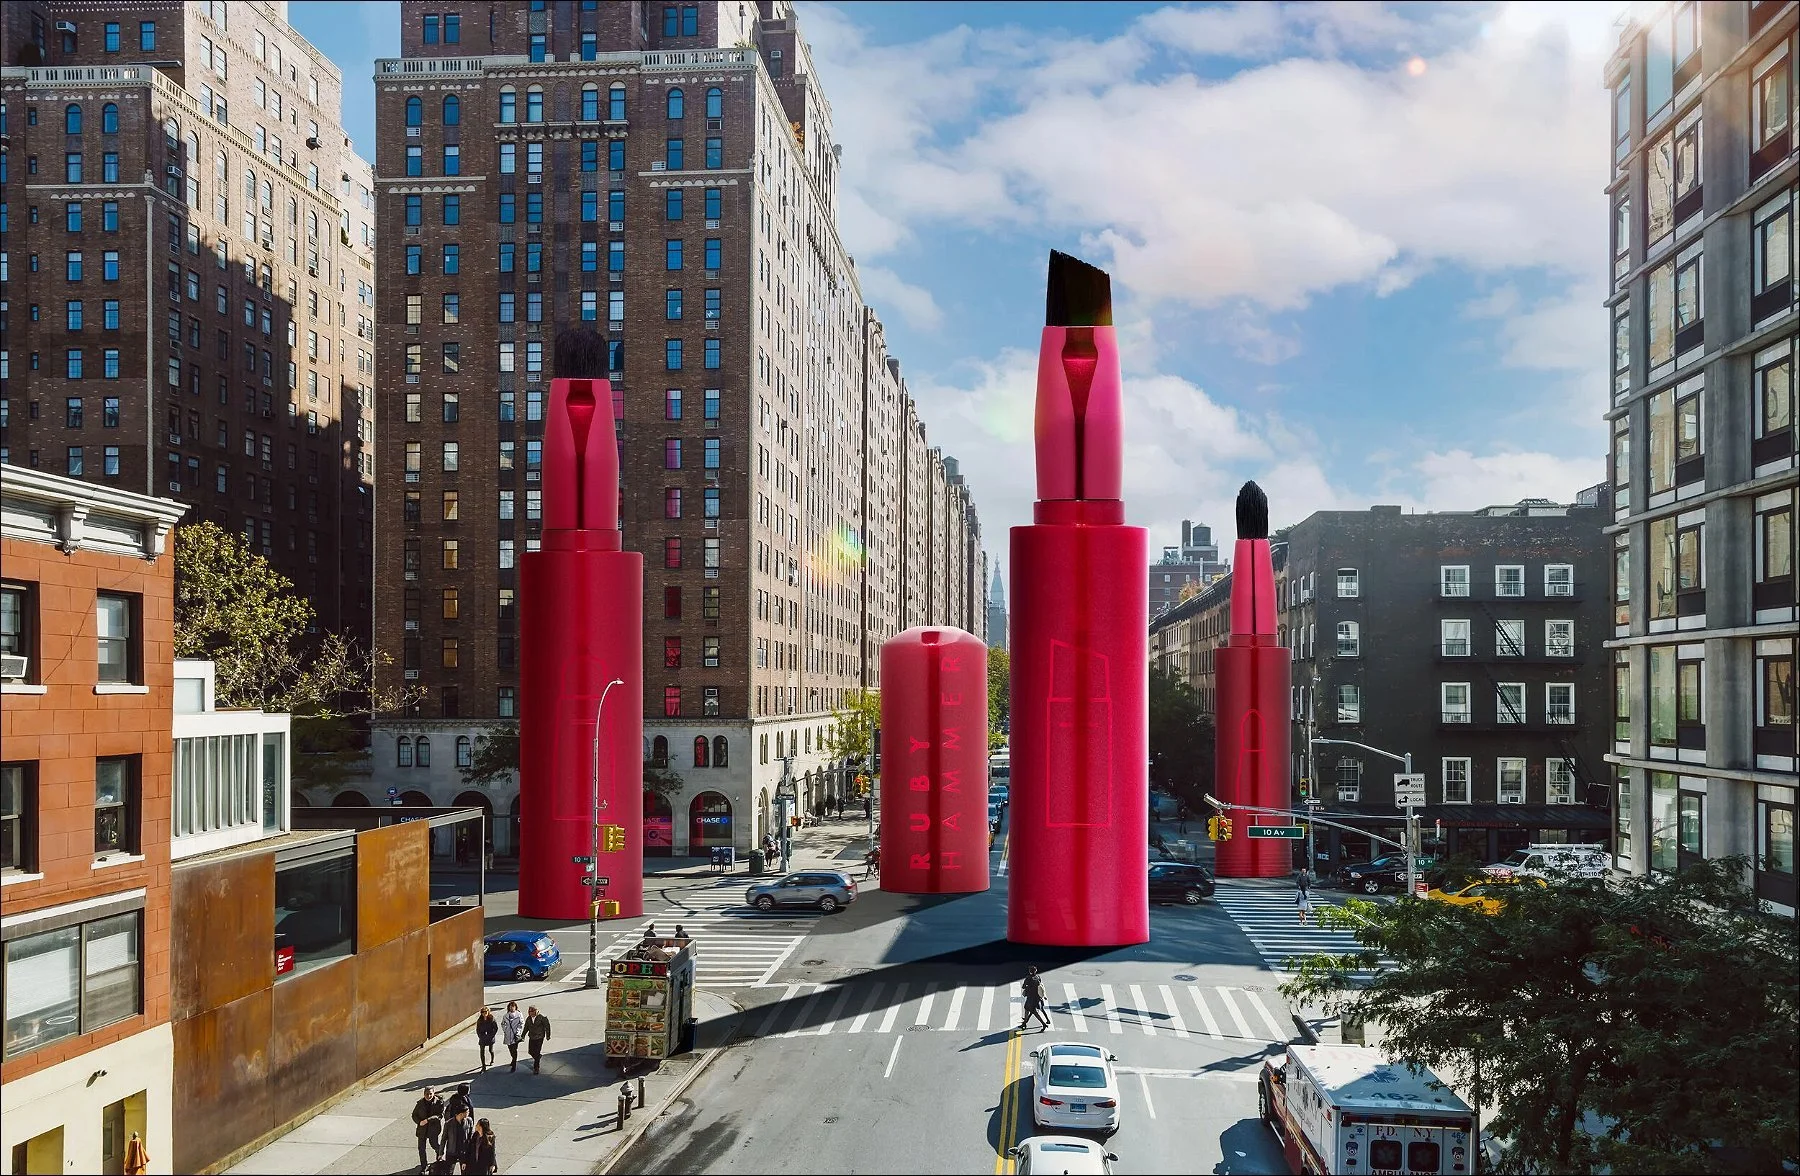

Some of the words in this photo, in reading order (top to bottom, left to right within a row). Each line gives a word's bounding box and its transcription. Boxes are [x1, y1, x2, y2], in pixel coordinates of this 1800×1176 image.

[941, 656, 961, 870] HAMMER
[909, 735, 930, 870] RUBY
[614, 962, 667, 975] OPEN
[1371, 1092, 1420, 1101] 462
[1376, 1126, 1398, 1137] F.D.
[1413, 1127, 1436, 1139] N.Y.
